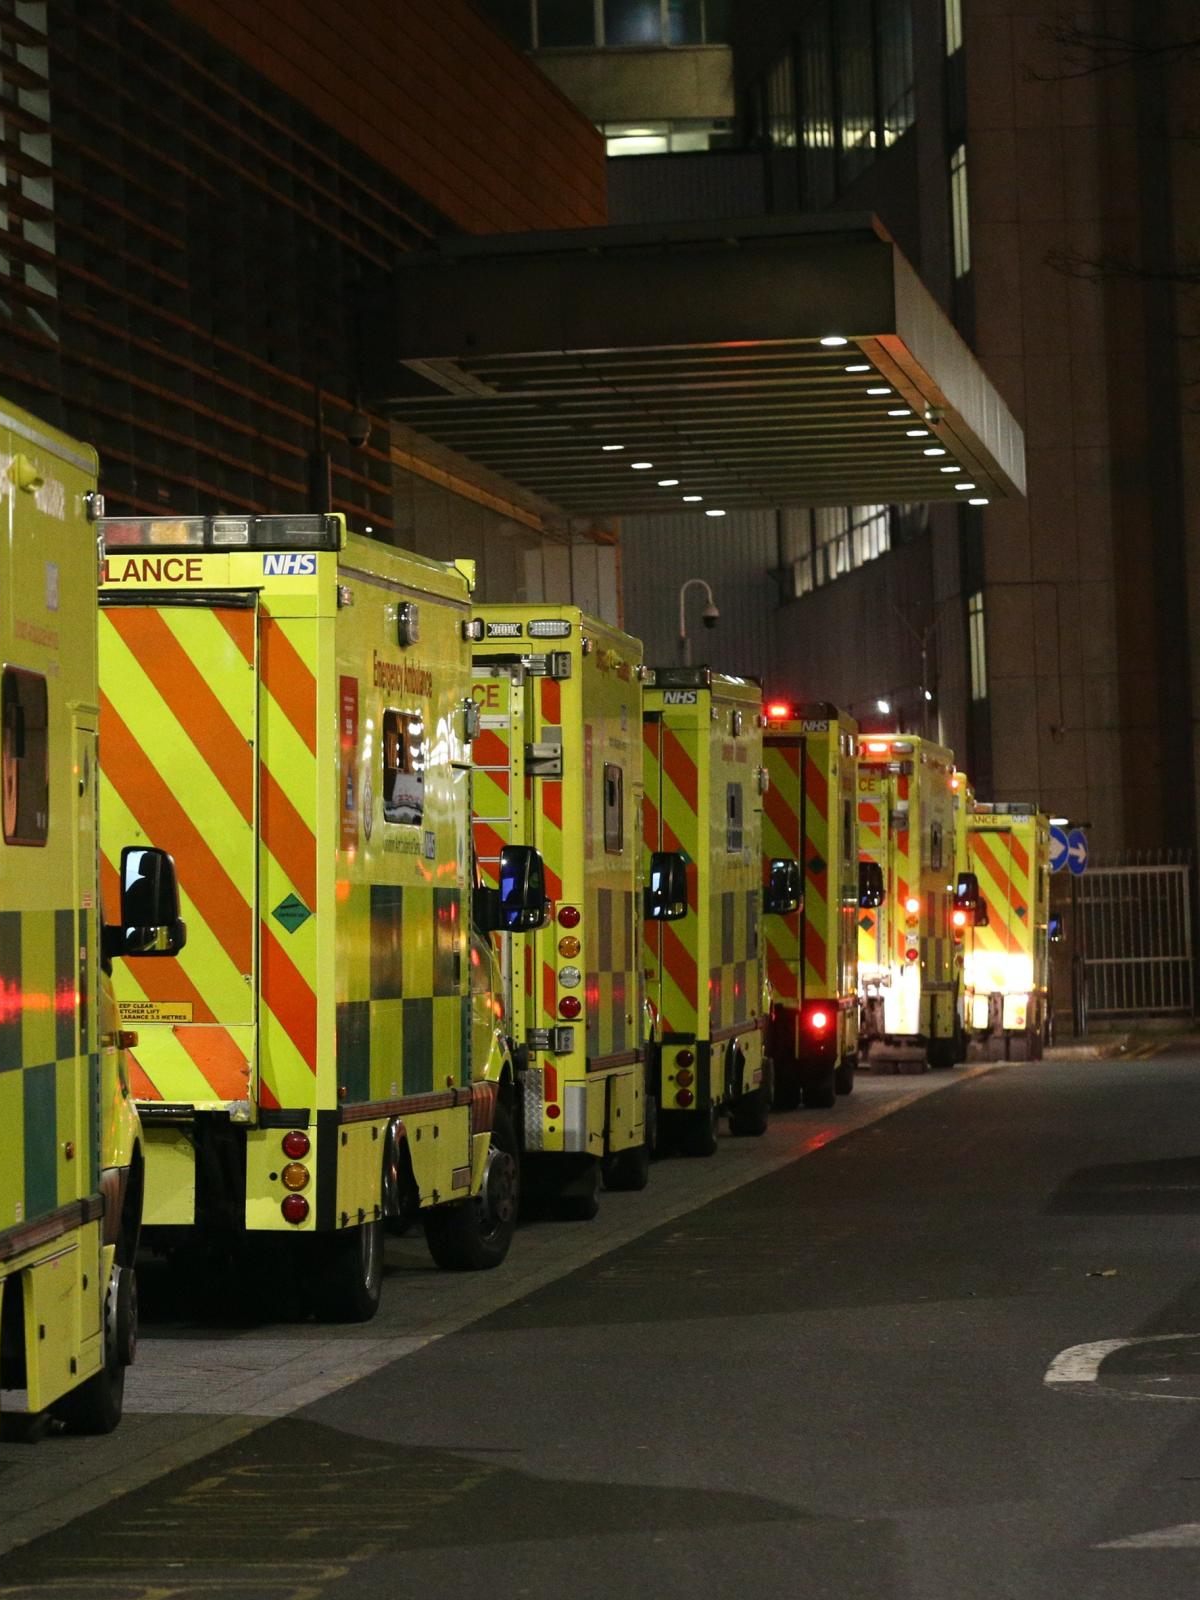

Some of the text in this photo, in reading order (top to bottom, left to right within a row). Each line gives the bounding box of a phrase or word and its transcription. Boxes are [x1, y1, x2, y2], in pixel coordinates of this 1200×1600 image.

[104, 558, 203, 582] LANCE
[263, 554, 316, 575] NHS
[374, 649, 402, 699] Emergency
[664, 690, 697, 704] NHS
[803, 720, 828, 731] NHS
